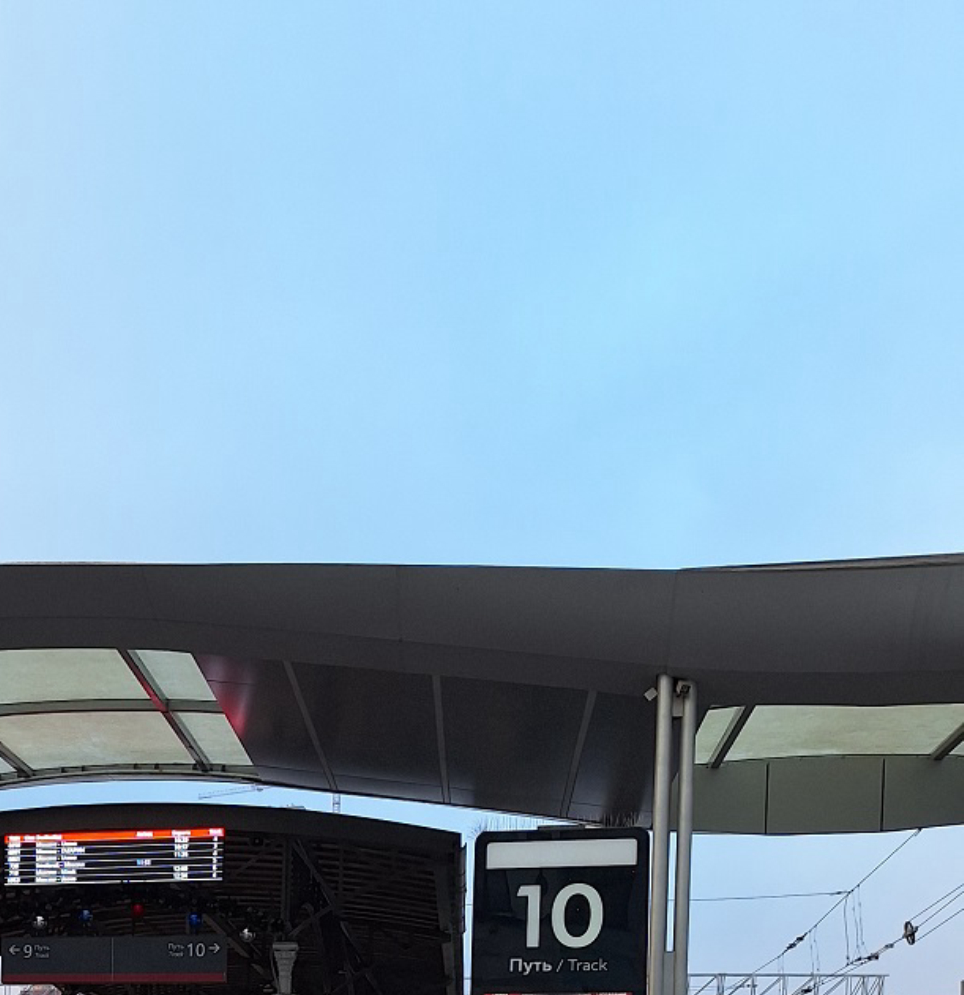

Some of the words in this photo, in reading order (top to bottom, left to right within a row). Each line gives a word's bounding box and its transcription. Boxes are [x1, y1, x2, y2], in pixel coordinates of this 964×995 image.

[516, 883, 604, 948] 10
[23, 944, 34, 959] 9
[187, 943, 206, 957] 10
[509, 958, 552, 977] Путь
[567, 958, 608, 973] Track
